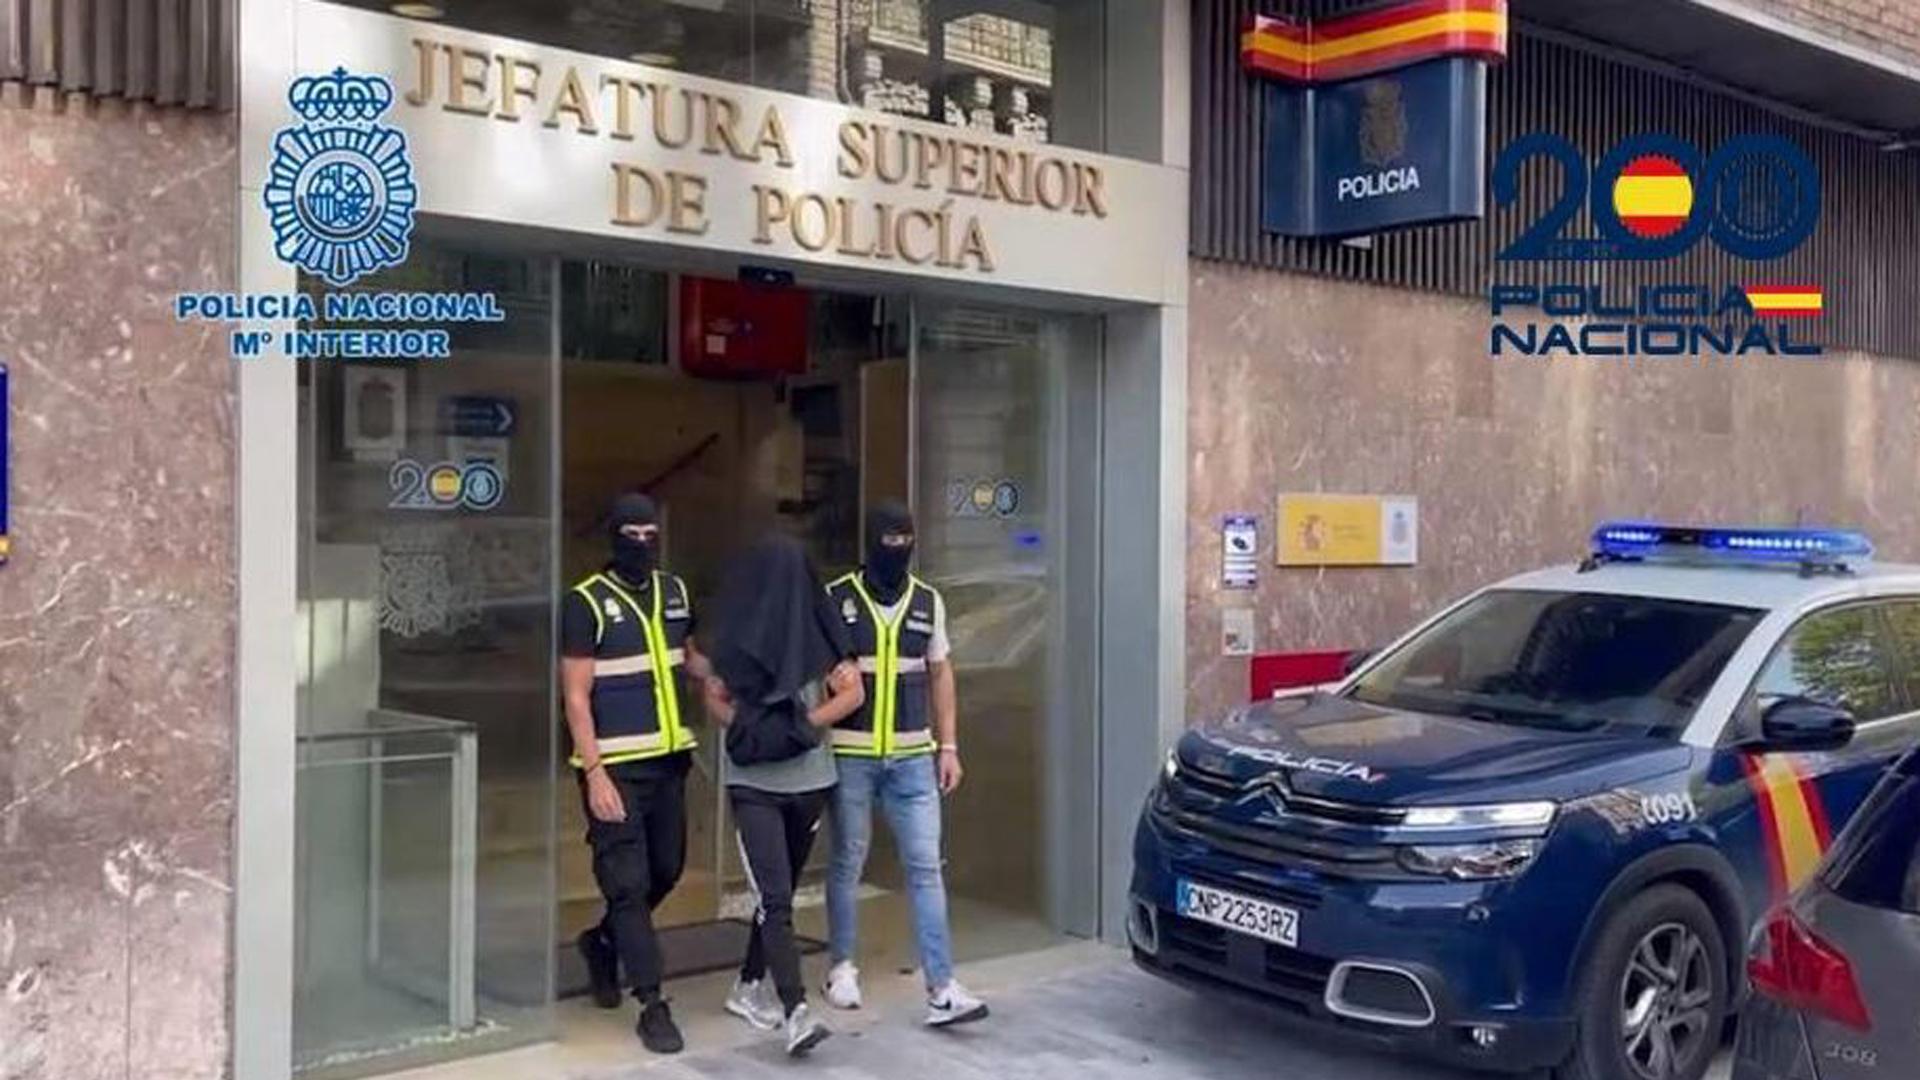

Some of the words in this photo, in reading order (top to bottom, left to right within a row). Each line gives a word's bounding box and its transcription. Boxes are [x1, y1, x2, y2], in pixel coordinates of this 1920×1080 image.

[405, 38, 792, 167] JEFATURA
[838, 121, 1107, 218] SUPERIOR
[610, 161, 709, 236] DE
[752, 184, 995, 272] POLICÍA
[1338, 166, 1420, 201] POLICIA
[1226, 746, 1370, 780] POLICIA
